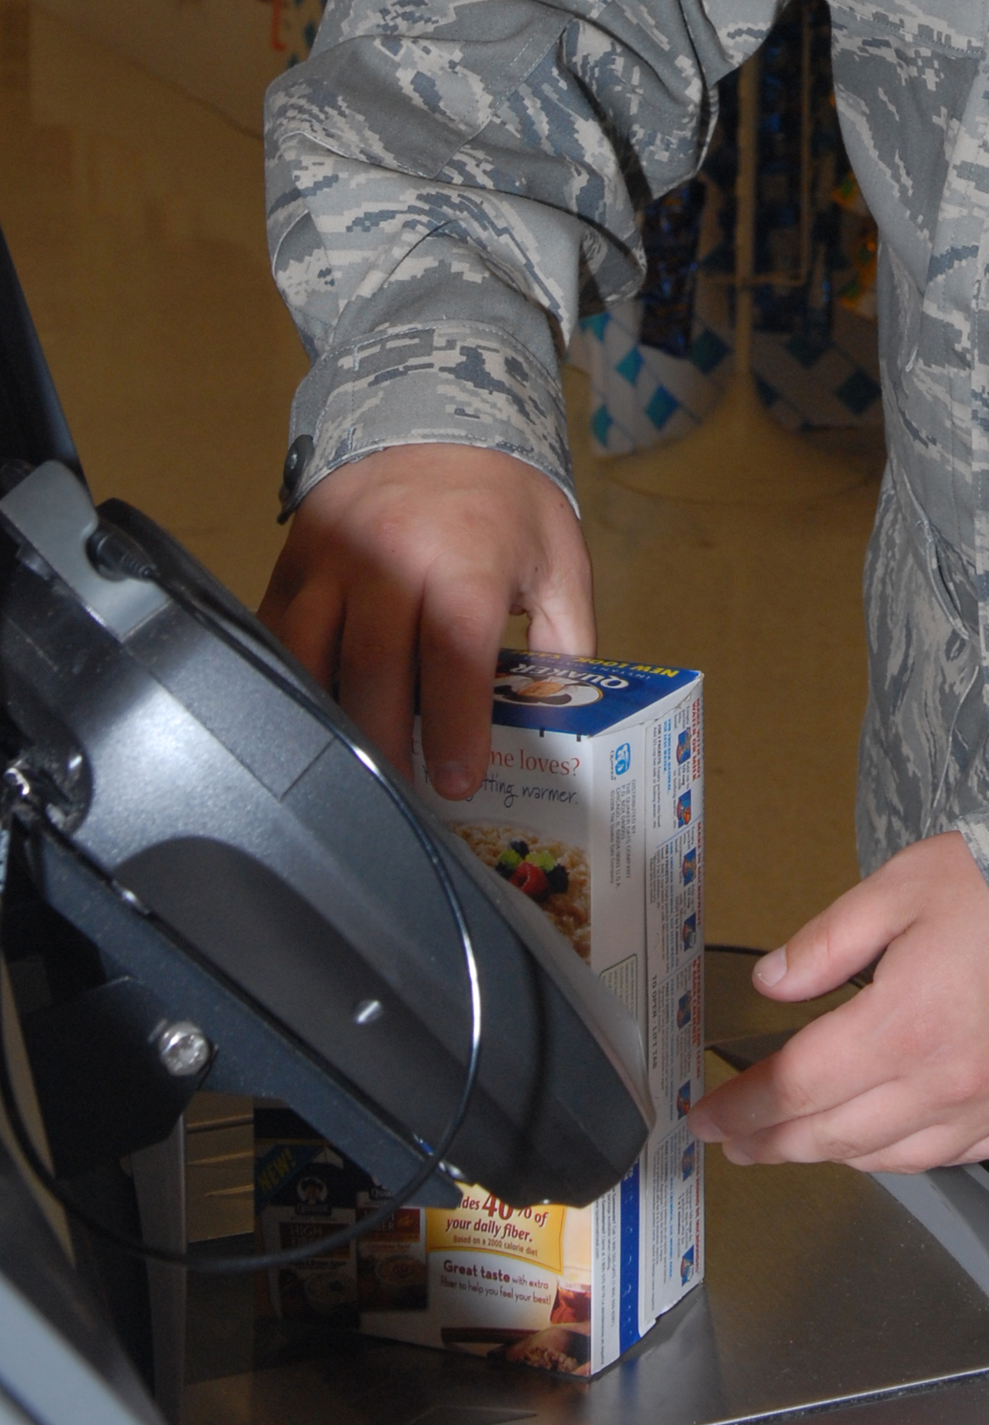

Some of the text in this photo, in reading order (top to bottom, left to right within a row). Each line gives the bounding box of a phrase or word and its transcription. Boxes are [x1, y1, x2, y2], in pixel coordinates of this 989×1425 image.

[509, 663, 629, 689] QUAKER
[630, 664, 679, 678] NEW
[520, 748, 580, 776] loves?
[522, 786, 578, 805] warmer.
[652, 975, 657, 988] TO
[257, 1147, 296, 1194] NEW!
[290, 1224, 322, 1235] HIGH
[534, 1211, 549, 1226] of
[445, 1219, 533, 1242] your daily fiber.
[453, 1235, 471, 1244] Based
[488, 1239, 502, 1248] 2000
[504, 1242, 524, 1253] calorie
[526, 1246, 538, 1257] diet
[443, 1259, 549, 1289] Great taste with extra
[459, 1282, 467, 1290] to
[468, 1281, 484, 1294] help
[485, 1287, 498, 1297] you
[499, 1286, 513, 1297] feel
[515, 1292, 531, 1302] your
[532, 1291, 552, 1305] best!
